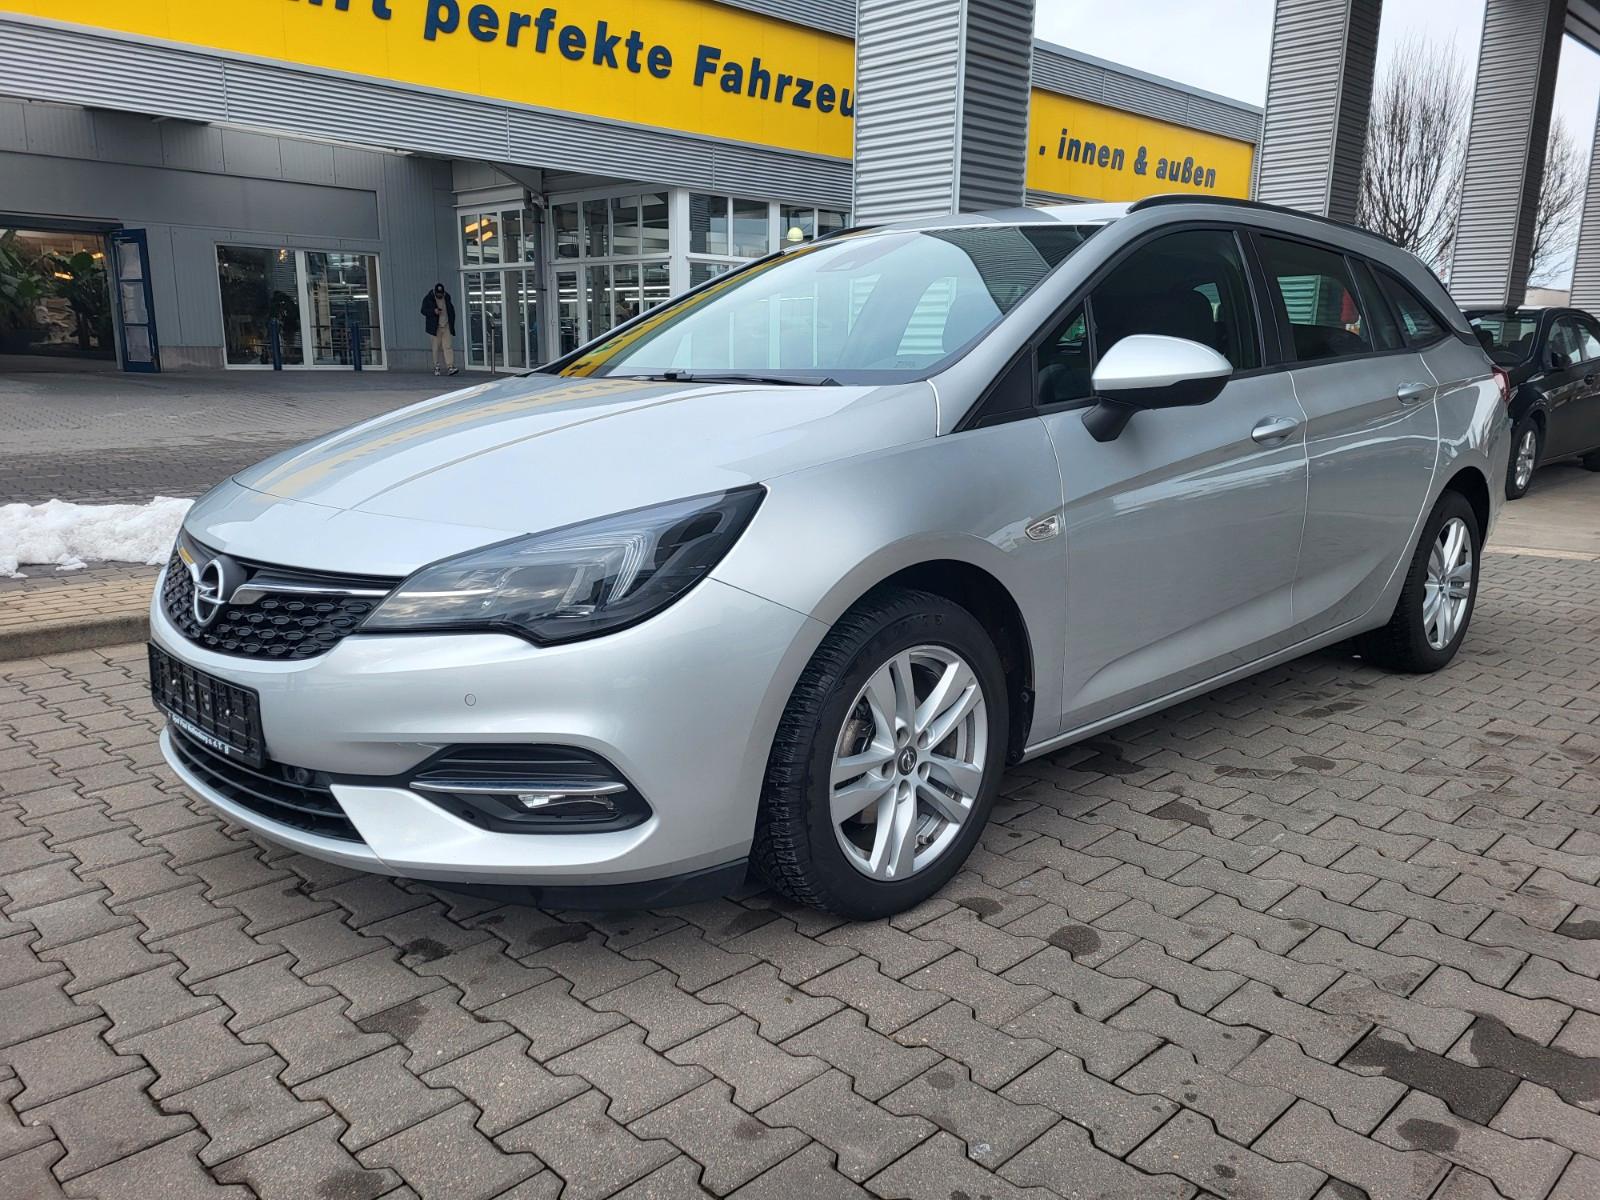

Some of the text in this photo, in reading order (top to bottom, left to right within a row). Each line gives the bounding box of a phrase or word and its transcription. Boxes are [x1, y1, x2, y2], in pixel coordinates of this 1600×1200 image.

[424, 0, 673, 79] perfekte
[1057, 128, 1125, 171] innen
[1133, 145, 1148, 176] &
[1155, 156, 1217, 188] außen
